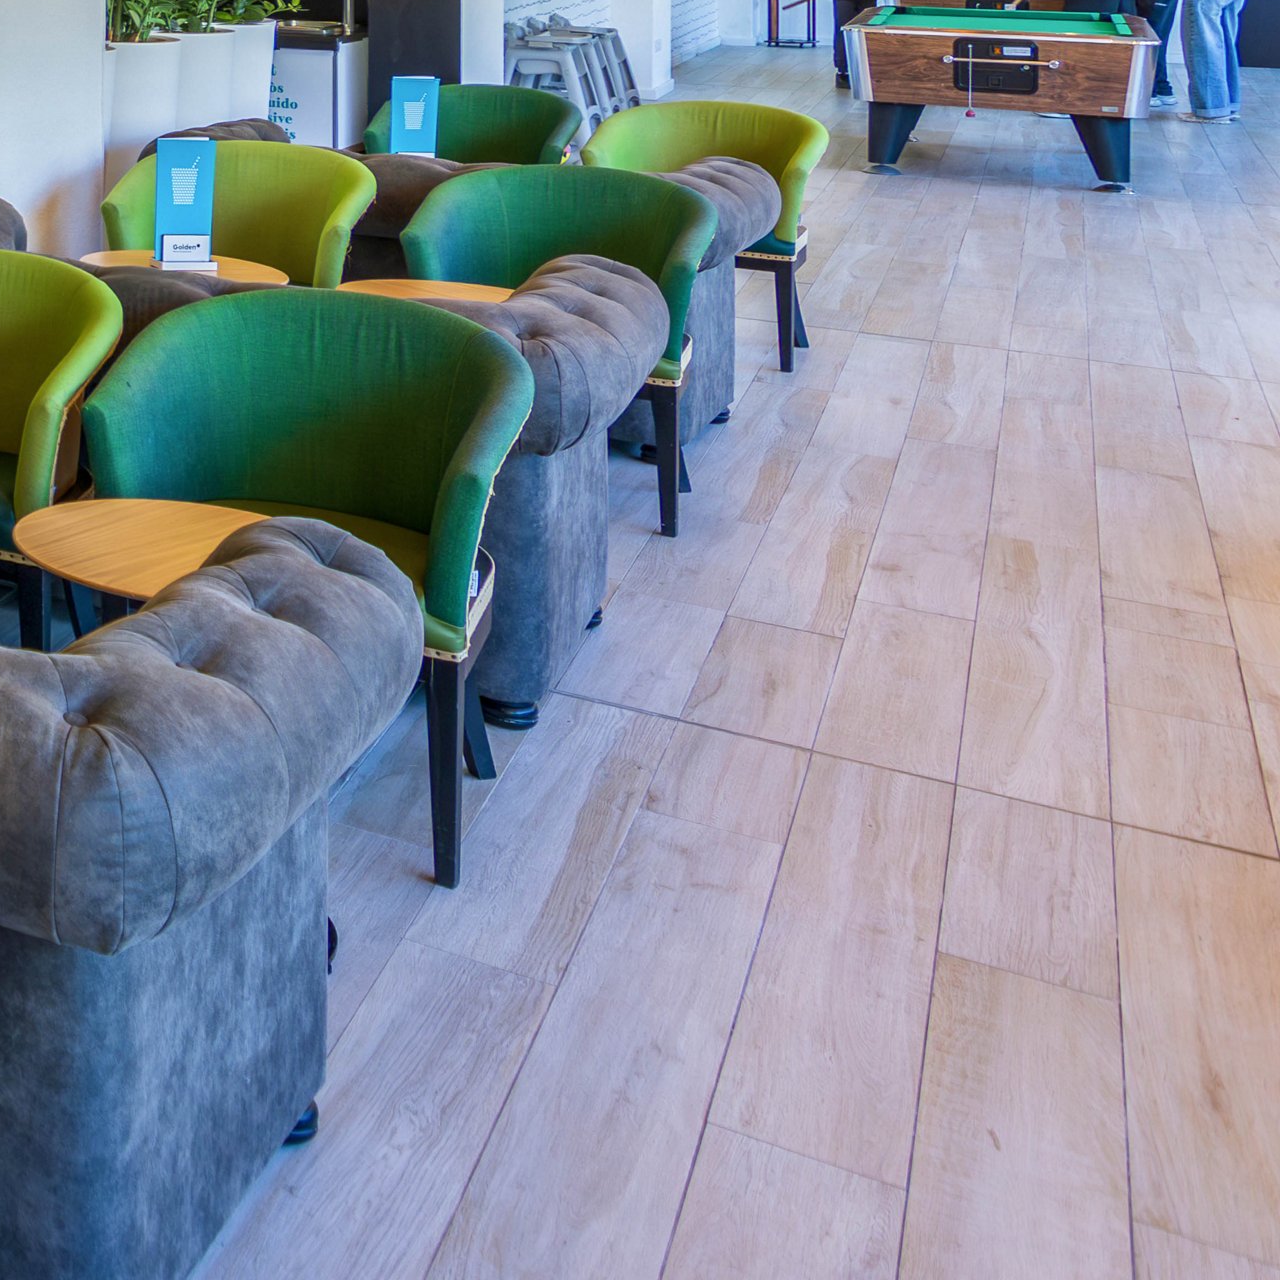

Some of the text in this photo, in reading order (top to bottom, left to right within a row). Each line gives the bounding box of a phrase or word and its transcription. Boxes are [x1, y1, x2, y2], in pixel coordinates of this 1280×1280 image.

[269, 98, 298, 109] uido
[268, 112, 293, 124] sive
[172, 243, 197, 251] Golden
